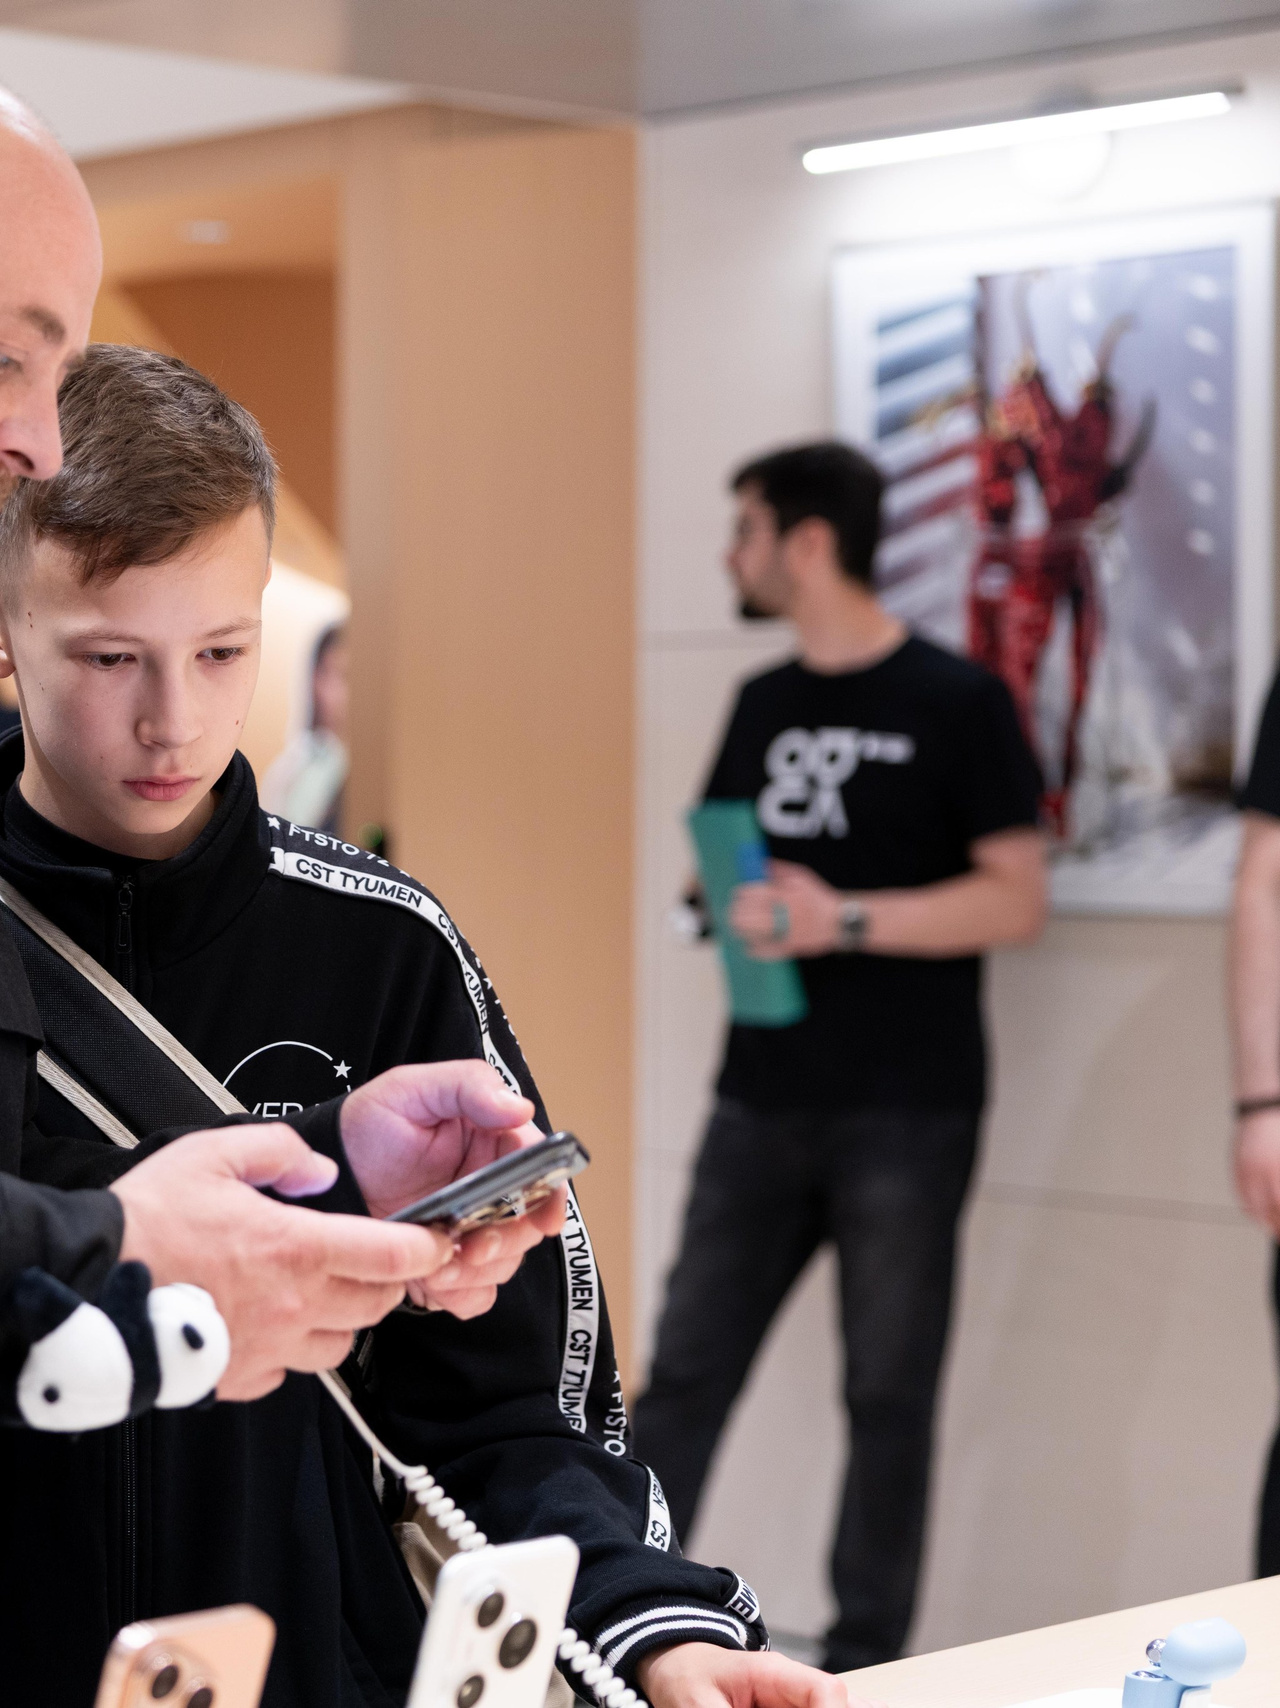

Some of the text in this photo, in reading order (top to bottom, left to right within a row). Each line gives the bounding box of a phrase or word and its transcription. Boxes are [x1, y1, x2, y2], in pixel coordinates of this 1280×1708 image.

[288, 823, 360, 856] FTSTO
[295, 858, 335, 884] CST
[340, 871, 422, 908] TYUMEN
[462, 960, 490, 1035] YUMEN
[565, 1227, 593, 1311] TYUMEN
[569, 1329, 592, 1366] CST
[649, 1519, 667, 1550] CS
